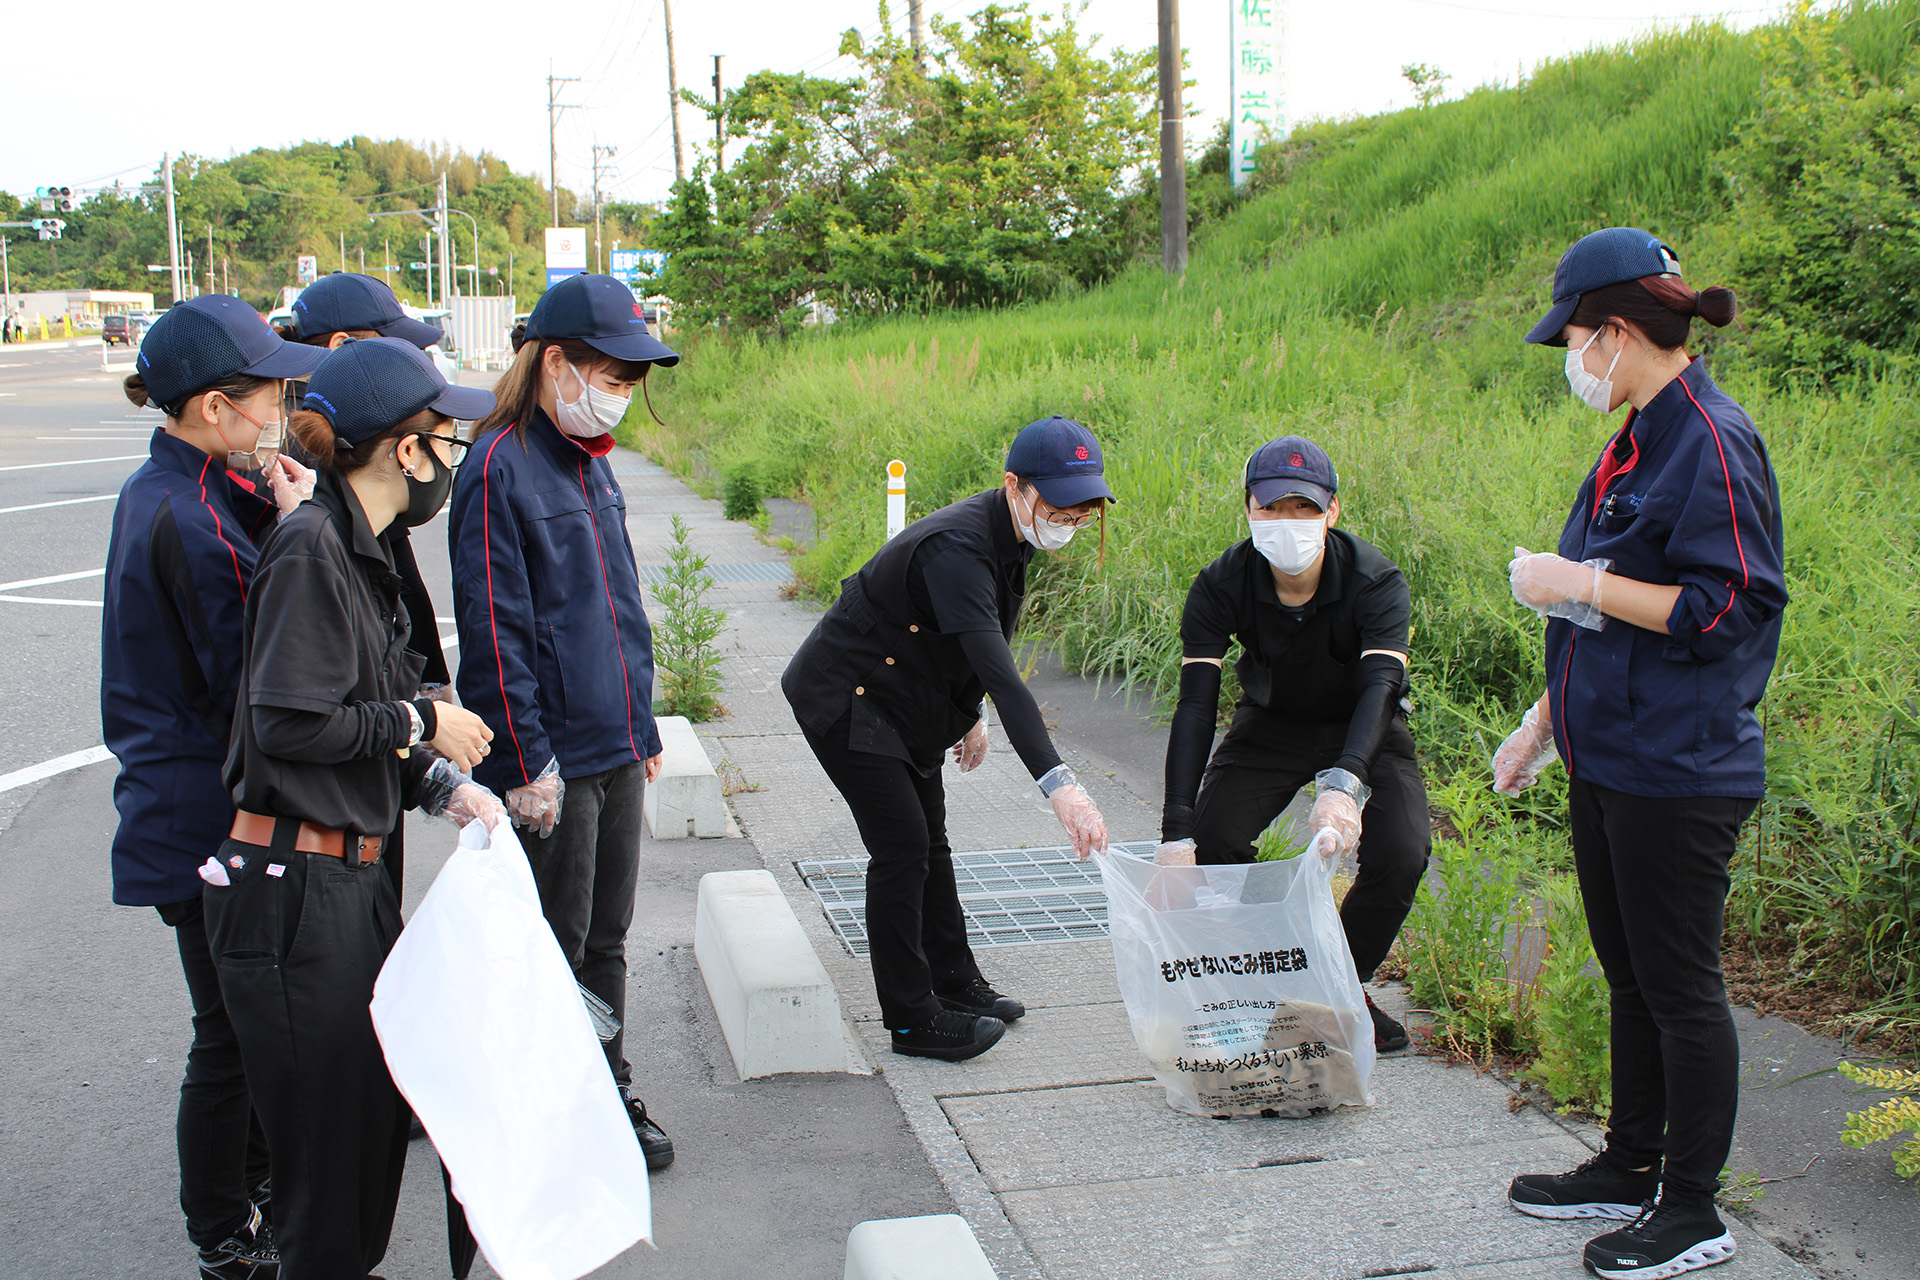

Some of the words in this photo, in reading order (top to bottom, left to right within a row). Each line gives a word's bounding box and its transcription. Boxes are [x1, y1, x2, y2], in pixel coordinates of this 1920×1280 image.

[1160, 948, 1308, 983] もやせないごみ指定袋
[1616, 1258, 1639, 1267] TULTEX
